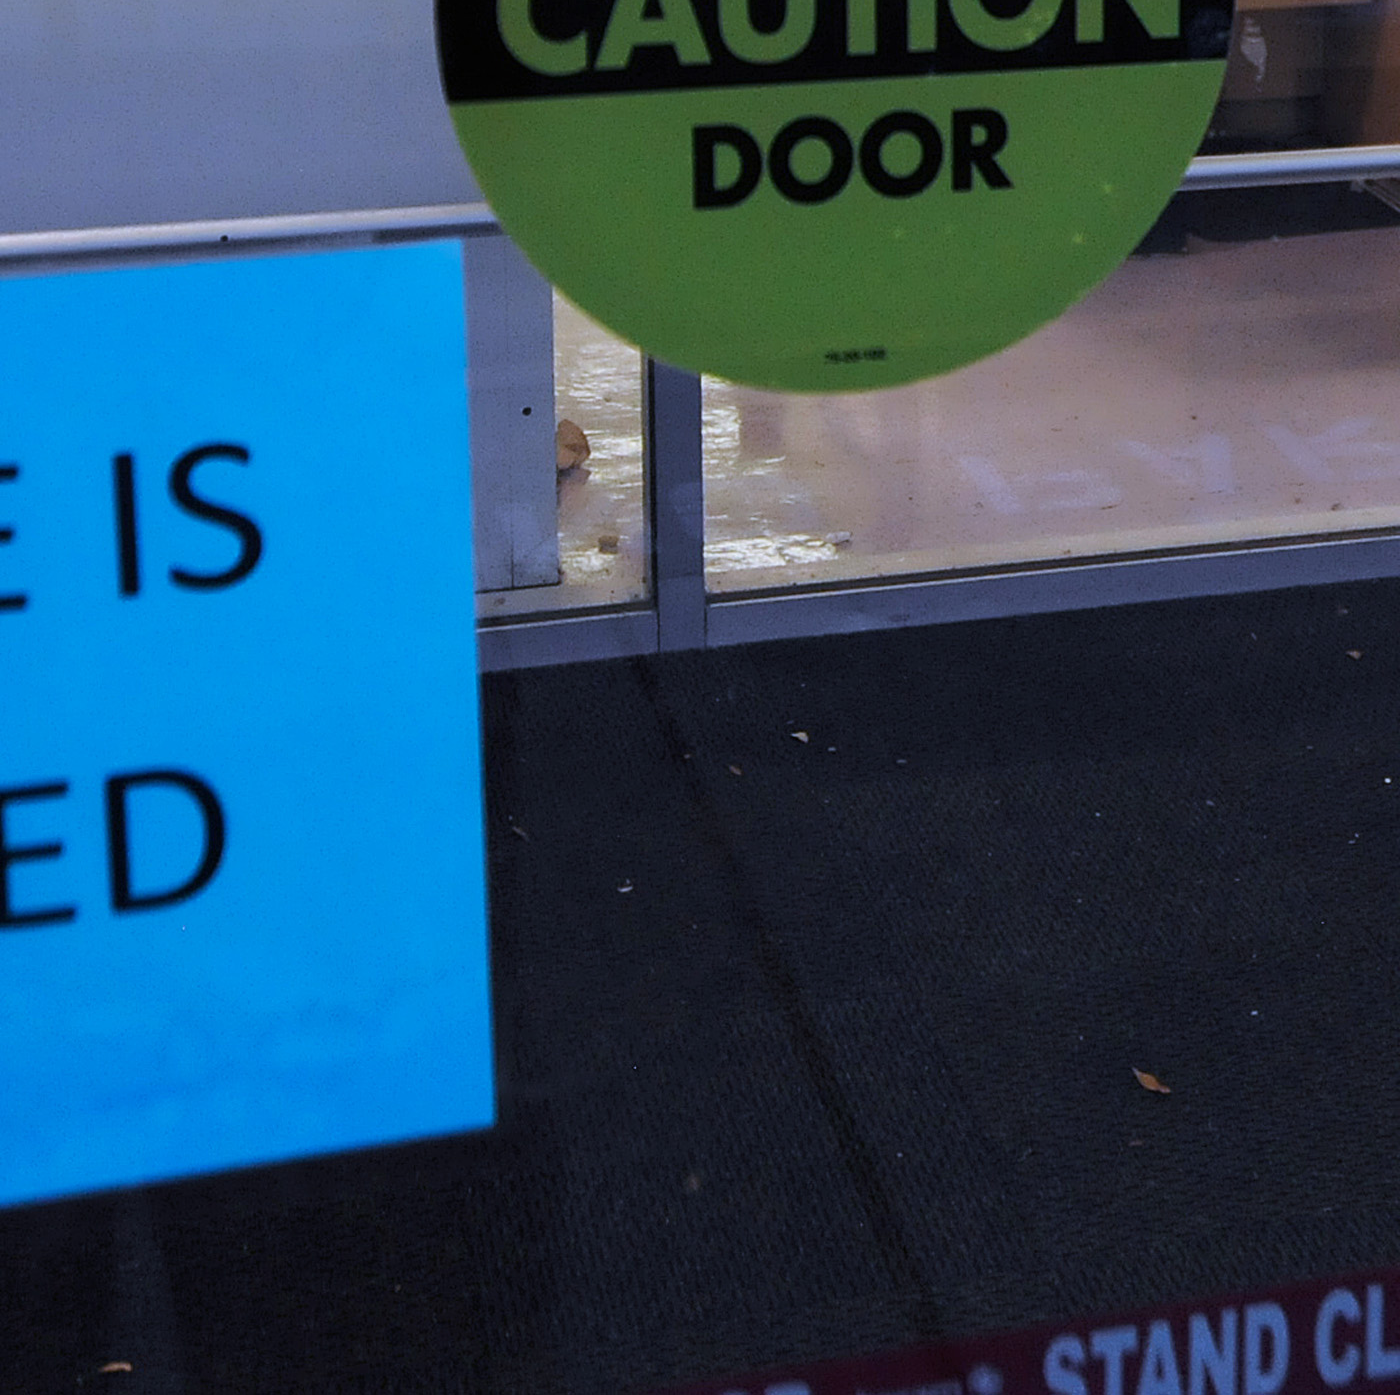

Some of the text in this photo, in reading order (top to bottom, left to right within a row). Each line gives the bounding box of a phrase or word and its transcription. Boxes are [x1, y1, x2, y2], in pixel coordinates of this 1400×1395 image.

[692, 108, 1015, 210] DOOR
[112, 441, 265, 599] IS
[1042, 1300, 1290, 1395] STAND
